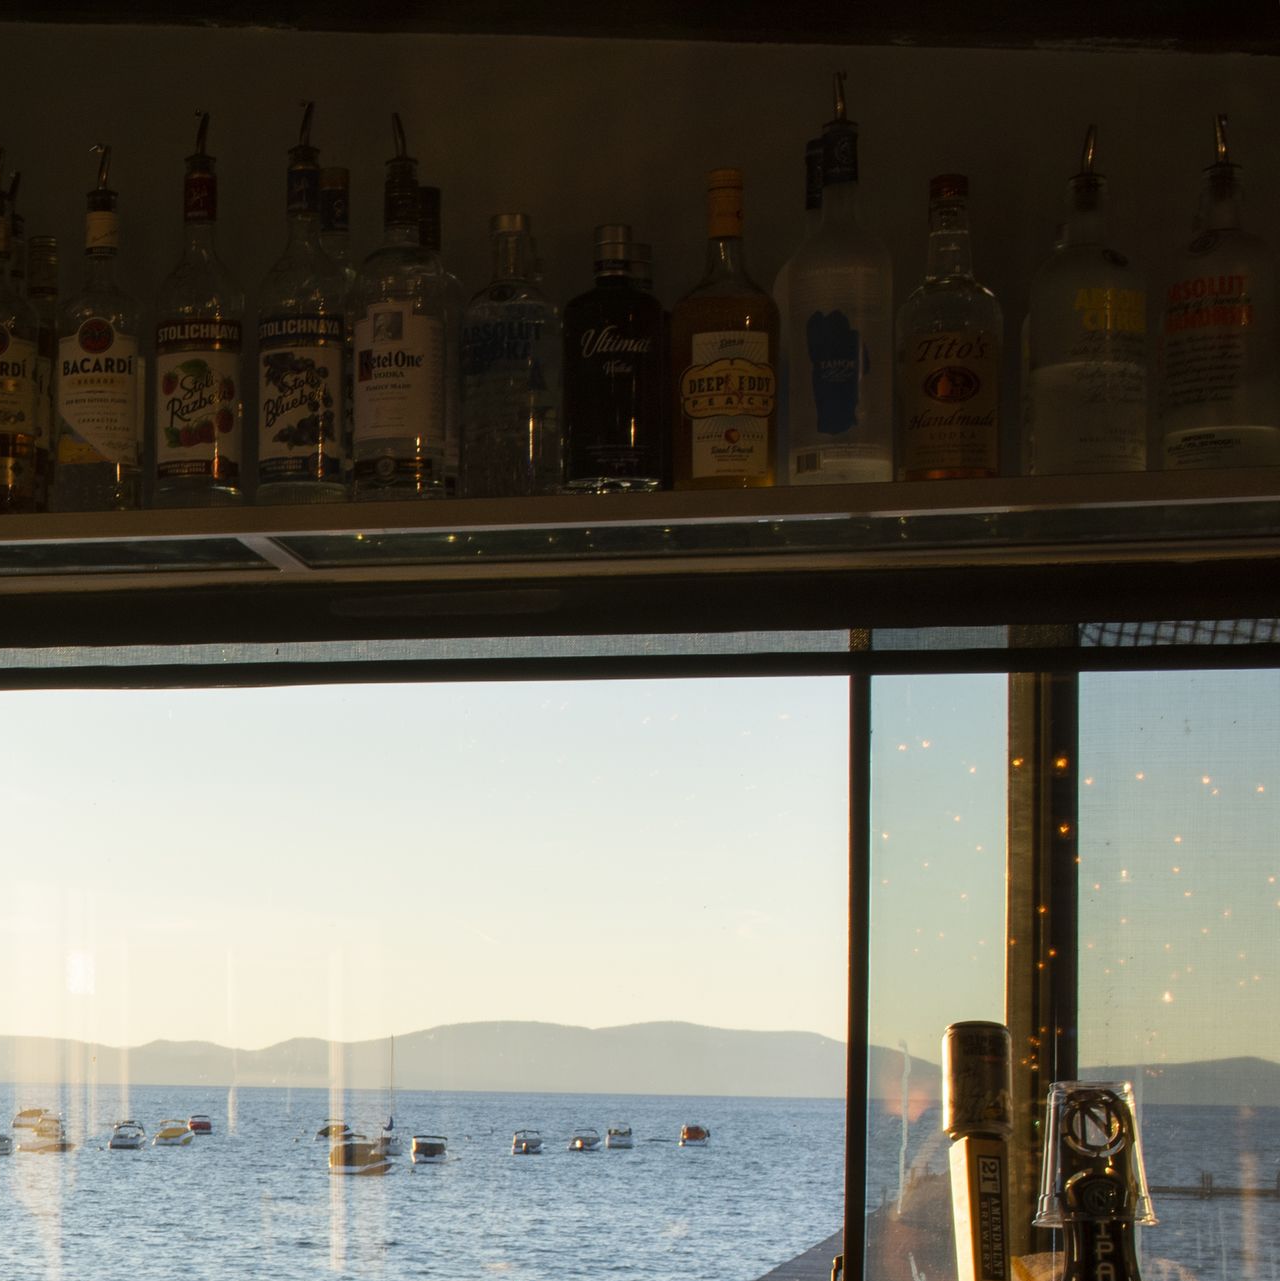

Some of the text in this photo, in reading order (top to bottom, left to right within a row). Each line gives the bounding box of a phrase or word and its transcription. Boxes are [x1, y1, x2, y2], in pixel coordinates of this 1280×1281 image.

[157, 323, 240, 344] STOLICHNAYA
[259, 318, 341, 339] STOLICHNAYA
[580, 325, 652, 359] Ultimat
[916, 335, 990, 363] Tito's
[62, 355, 133, 376] BACARDÍ
[394, 350, 423, 369] One
[374, 371, 405, 380] VODKA
[689, 374, 773, 394] DEEP EDDY
[691, 397, 770, 409] PEACH
[980, 1200, 992, 1271] BREWERY
[990, 1194, 1005, 1280] AMENDMENT
